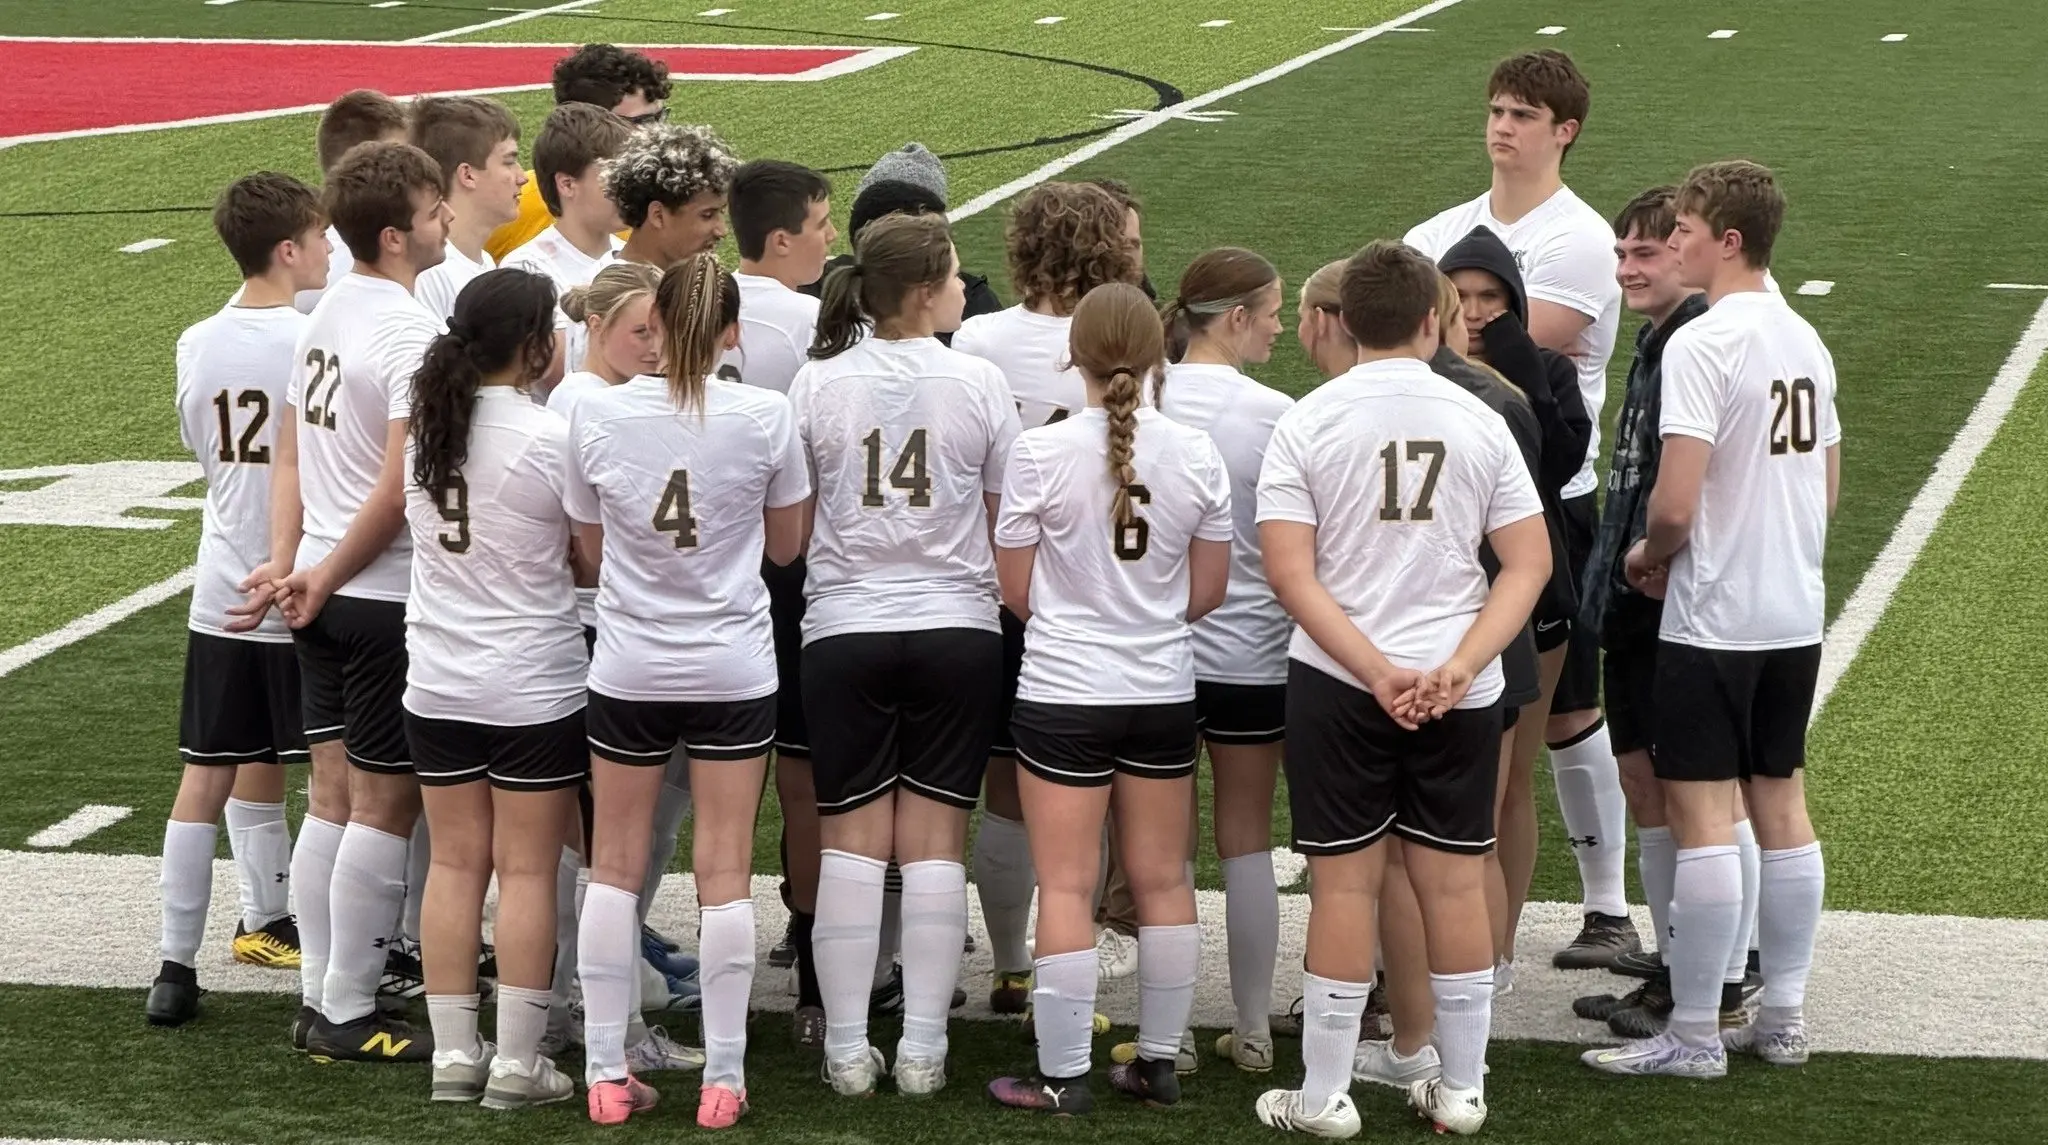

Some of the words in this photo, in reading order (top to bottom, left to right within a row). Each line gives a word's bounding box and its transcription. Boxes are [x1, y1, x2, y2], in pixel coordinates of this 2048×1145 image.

[212, 387, 271, 465] 12
[305, 347, 342, 432] 22
[1769, 376, 1817, 455] 20
[862, 427, 932, 507] 14
[1379, 439, 1447, 521] 17
[434, 474, 471, 555] 9
[651, 467, 698, 549] 4
[1113, 483, 1151, 562] 6
